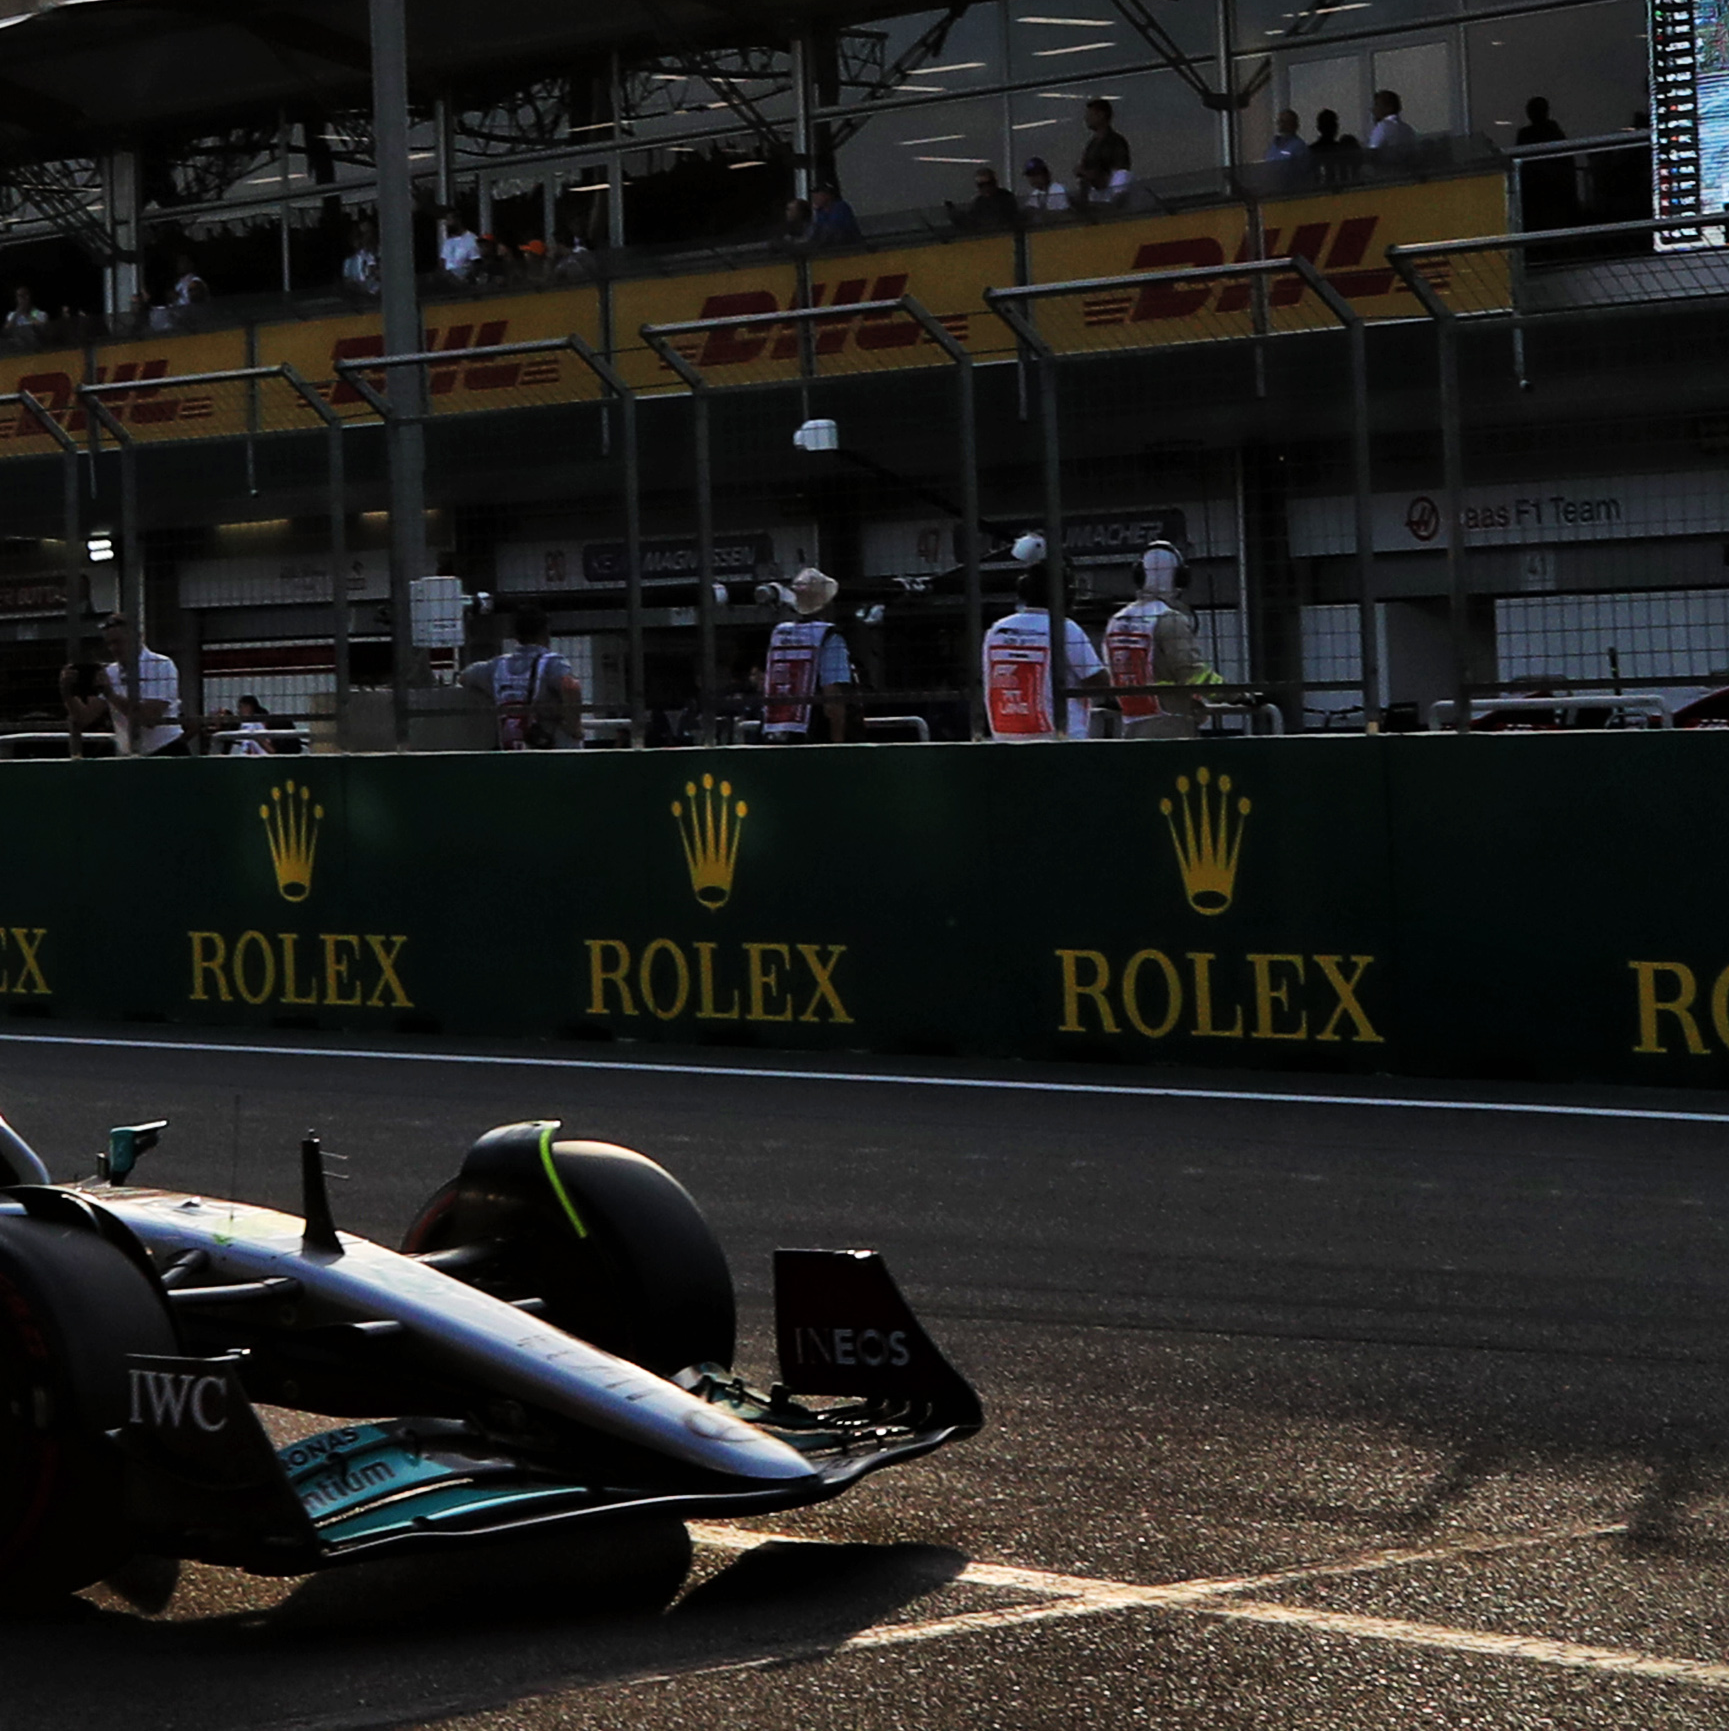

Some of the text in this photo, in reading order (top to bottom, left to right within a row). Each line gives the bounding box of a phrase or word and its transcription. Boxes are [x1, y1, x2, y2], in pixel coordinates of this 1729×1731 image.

[1130, 216, 1395, 321] DHL
[699, 273, 921, 365] DHL
[17, 359, 179, 435] DHL
[1456, 496, 1622, 530] aas F1 Team
[189, 930, 414, 1009] ROLEX
[585, 938, 853, 1023] ROLEX
[1055, 949, 1385, 1042] ROLEX
[794, 1327, 911, 1366] INEOS
[129, 1370, 228, 1432] IWC
